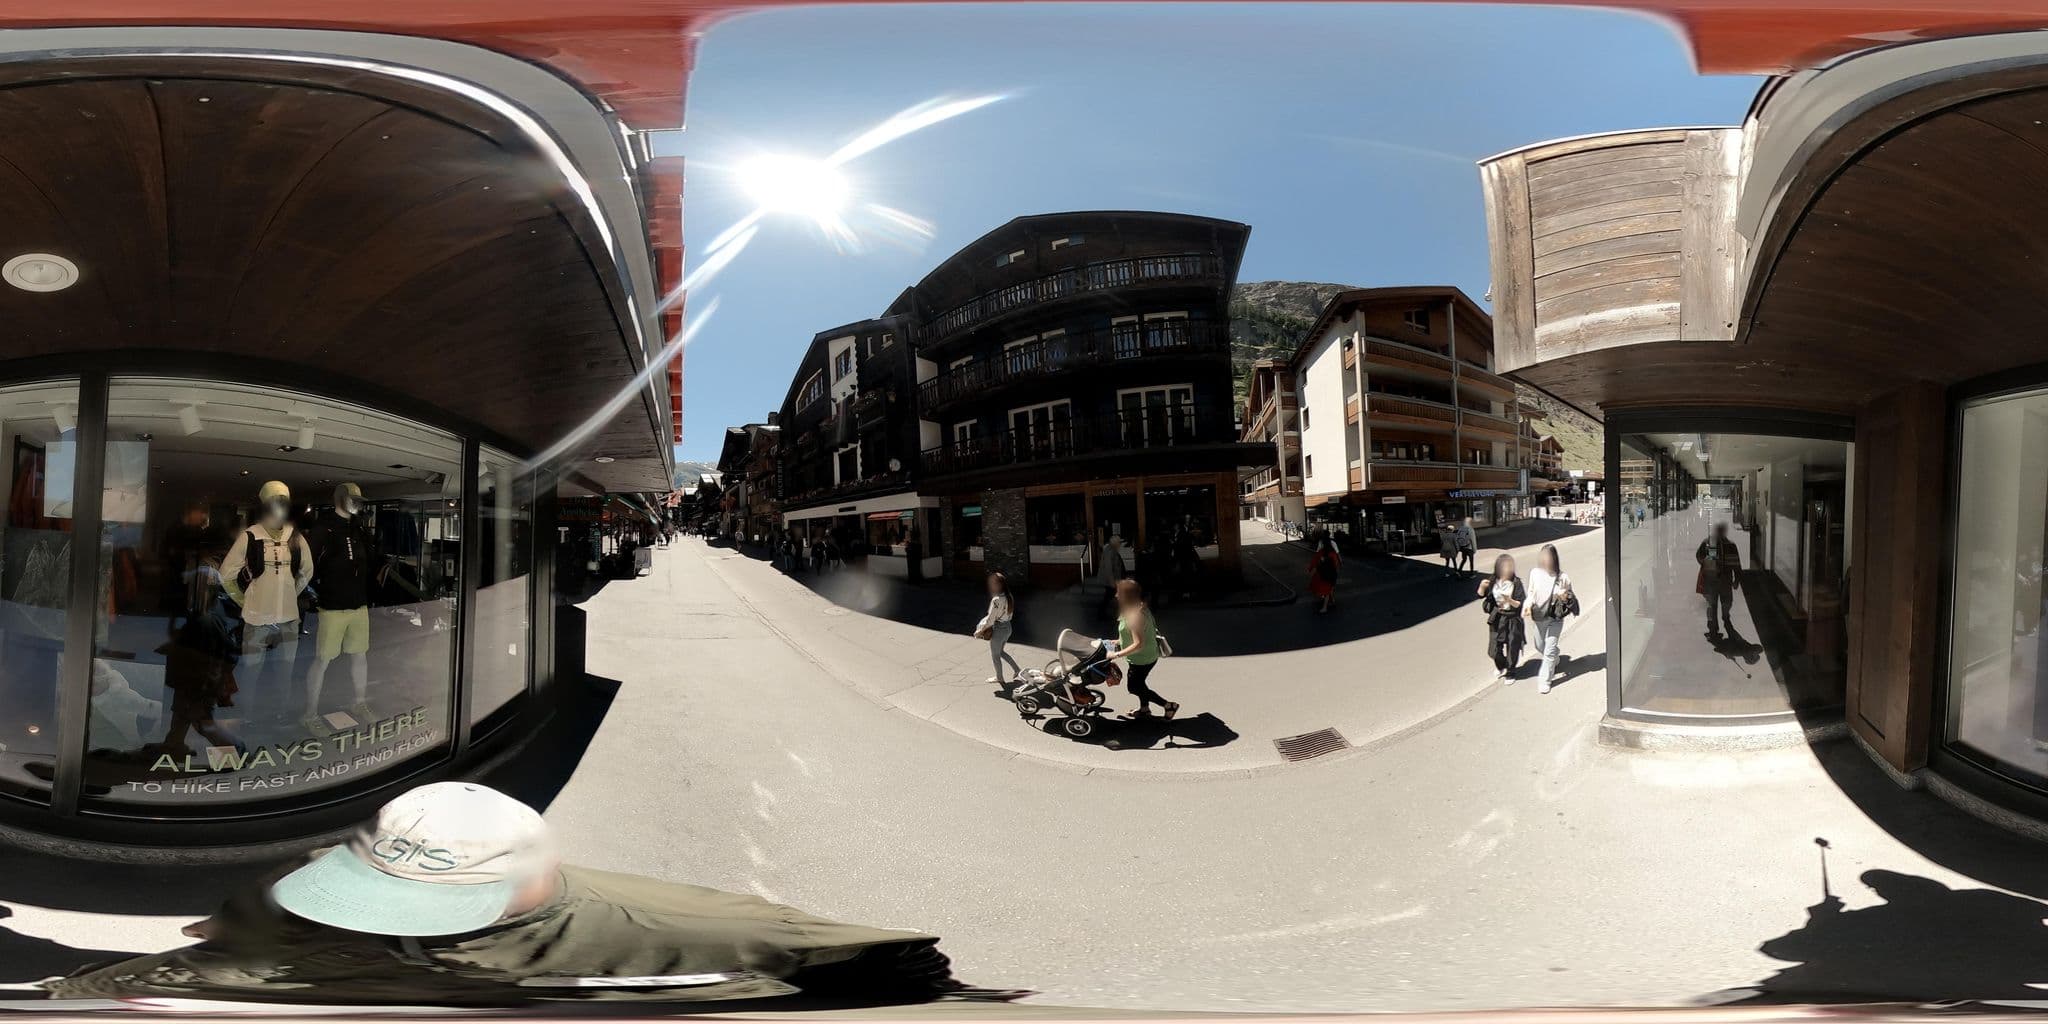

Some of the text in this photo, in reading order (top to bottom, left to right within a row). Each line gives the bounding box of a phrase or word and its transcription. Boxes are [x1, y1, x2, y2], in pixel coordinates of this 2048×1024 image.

[126, 729, 438, 795] TO HIKE FAST AND FIND FLOW
[150, 707, 429, 773] ALWAYS THERE
